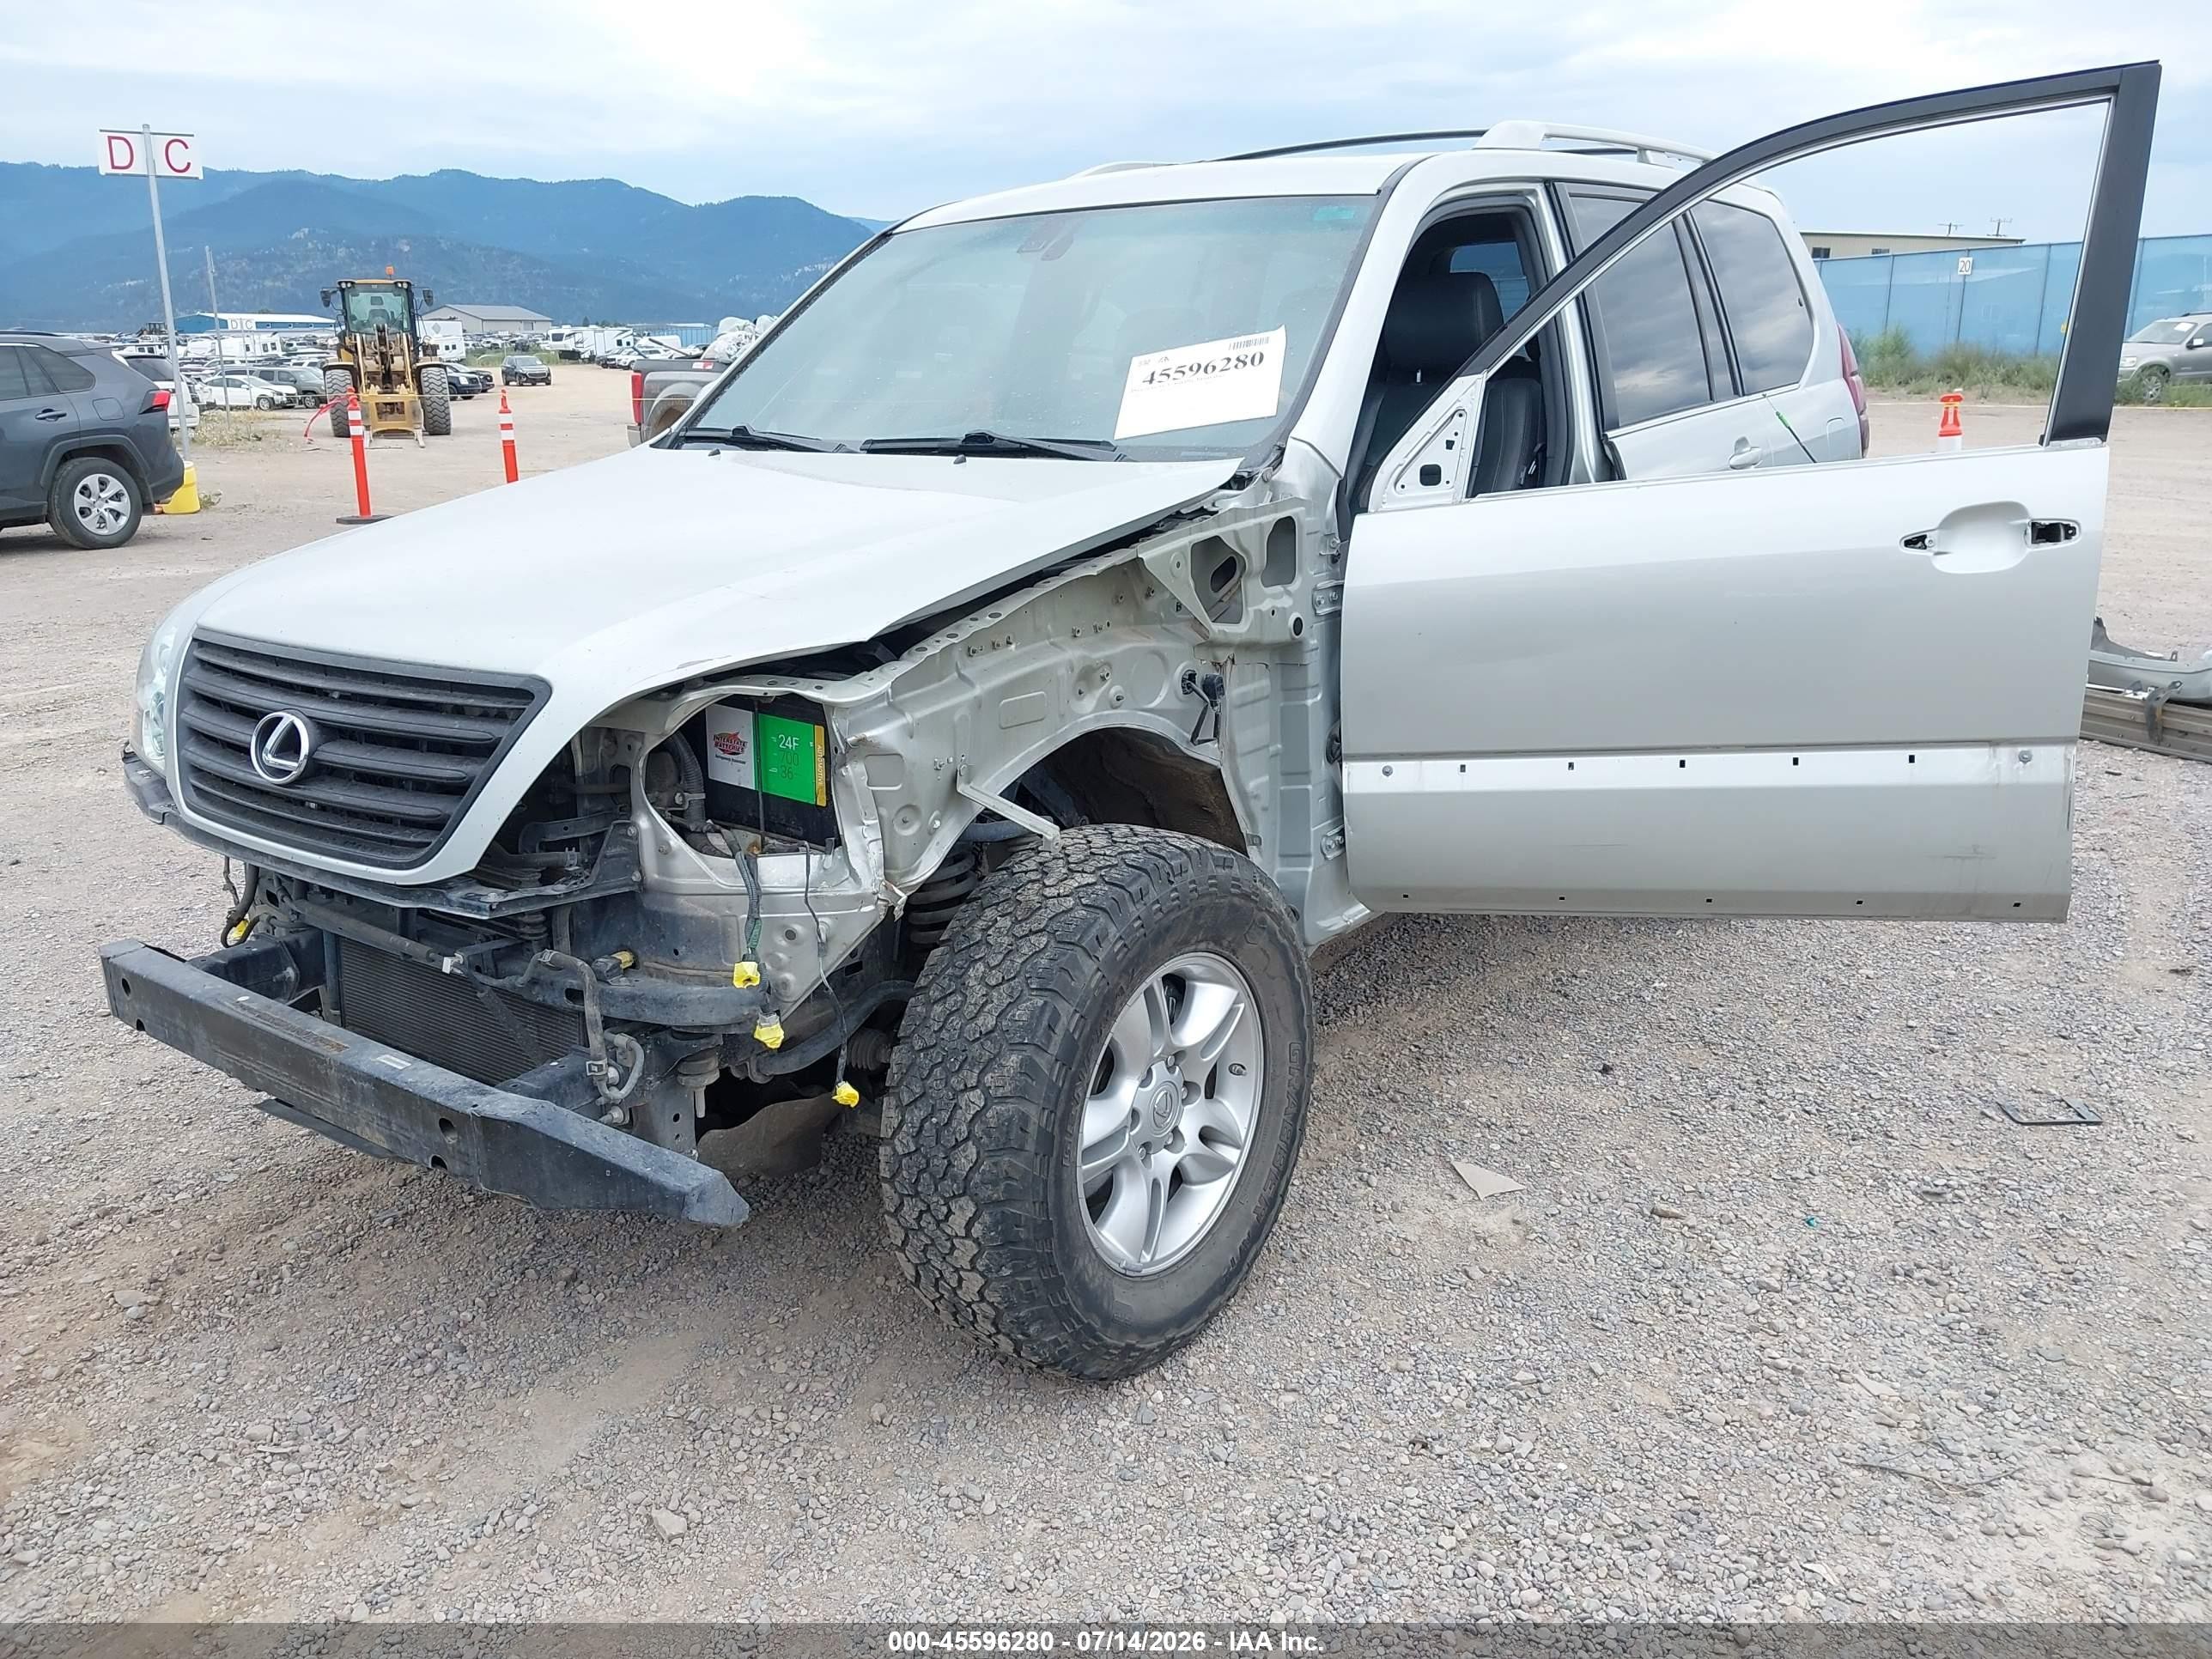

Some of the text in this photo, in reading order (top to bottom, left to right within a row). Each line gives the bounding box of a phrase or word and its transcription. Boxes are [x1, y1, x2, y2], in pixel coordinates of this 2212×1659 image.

[107, 135, 191, 173] D C
[1959, 259, 1971, 272] 20
[230, 319, 253, 329] D C
[1141, 350, 1264, 385] 45596280
[778, 734, 799, 750] 24F
[1252, 1041, 1304, 1224] GRABBER
